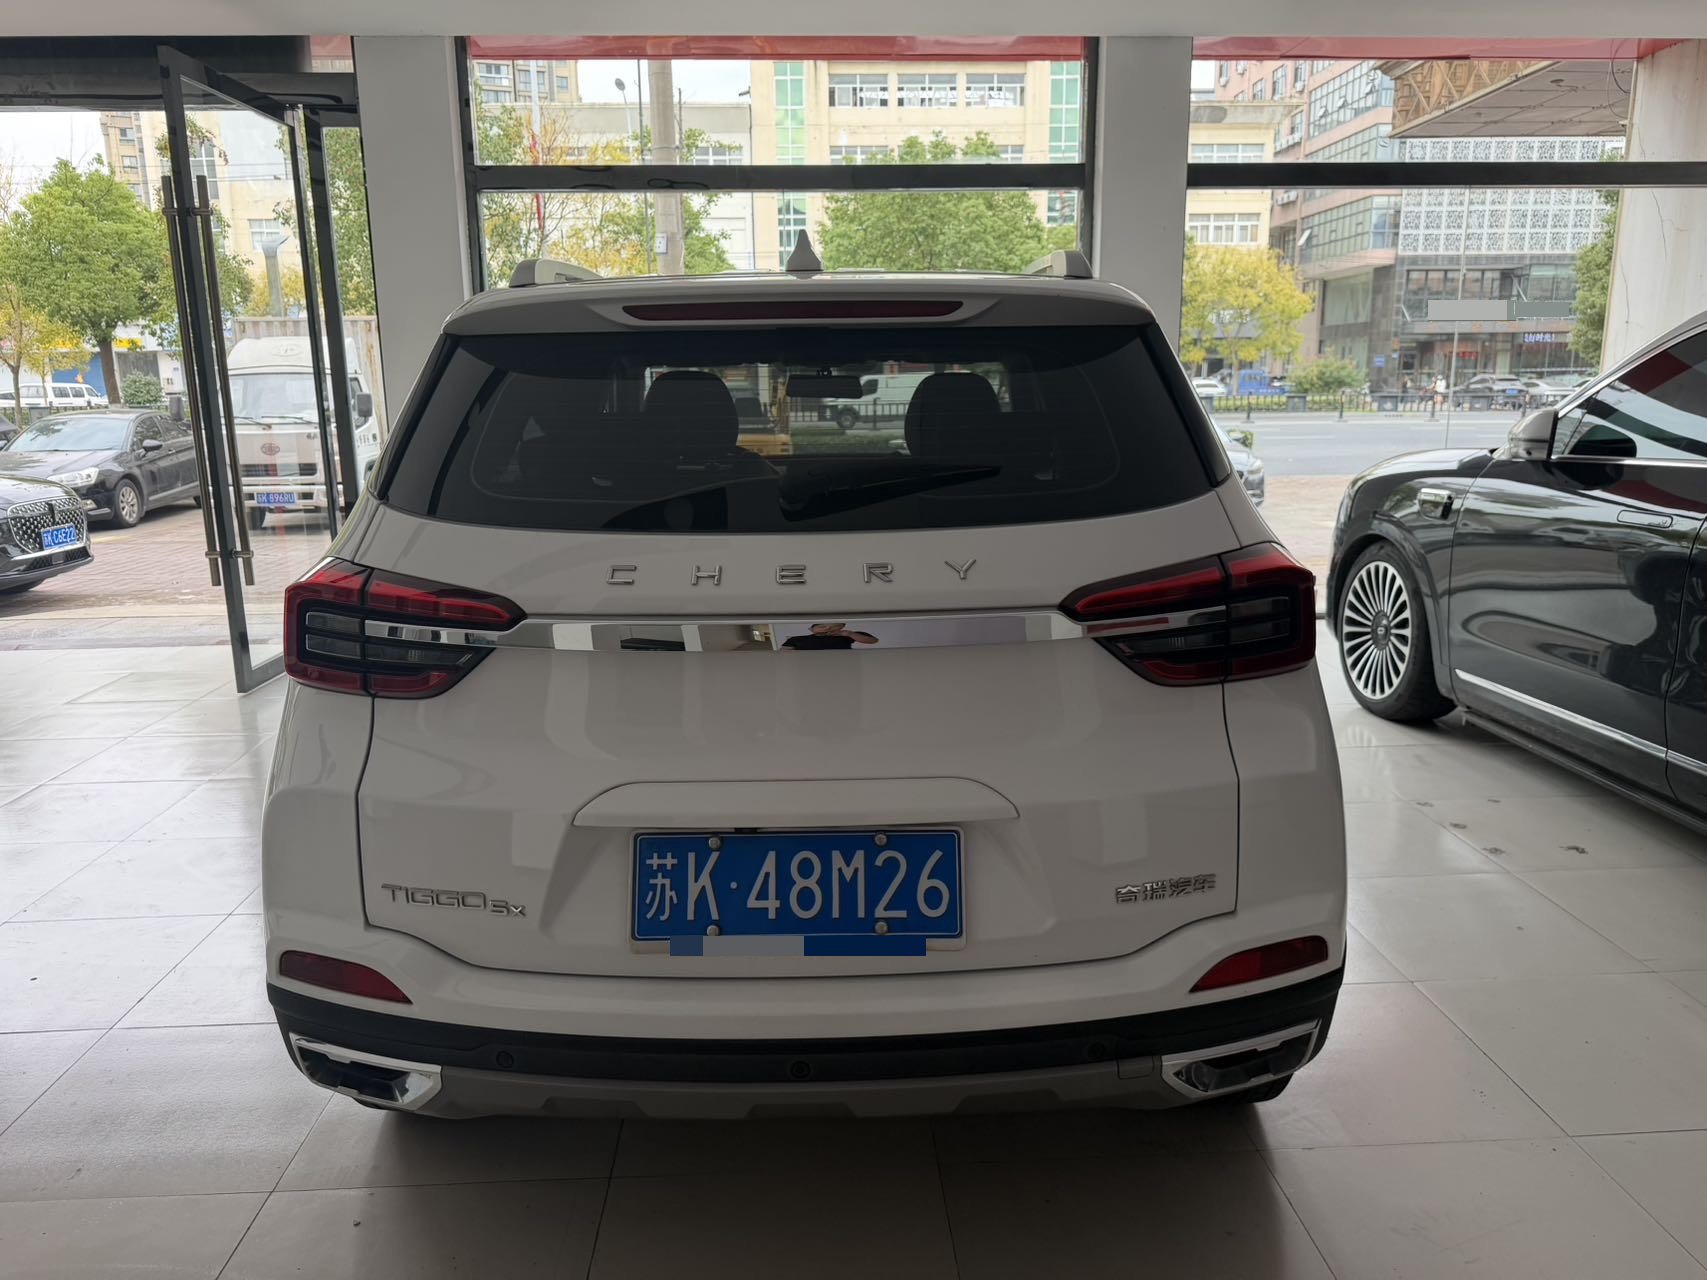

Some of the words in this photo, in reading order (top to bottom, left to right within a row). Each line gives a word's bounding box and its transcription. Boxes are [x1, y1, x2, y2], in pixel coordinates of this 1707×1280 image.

[606, 558, 977, 586] CHERY
[1115, 873, 1216, 904] 奇瑞汽车
